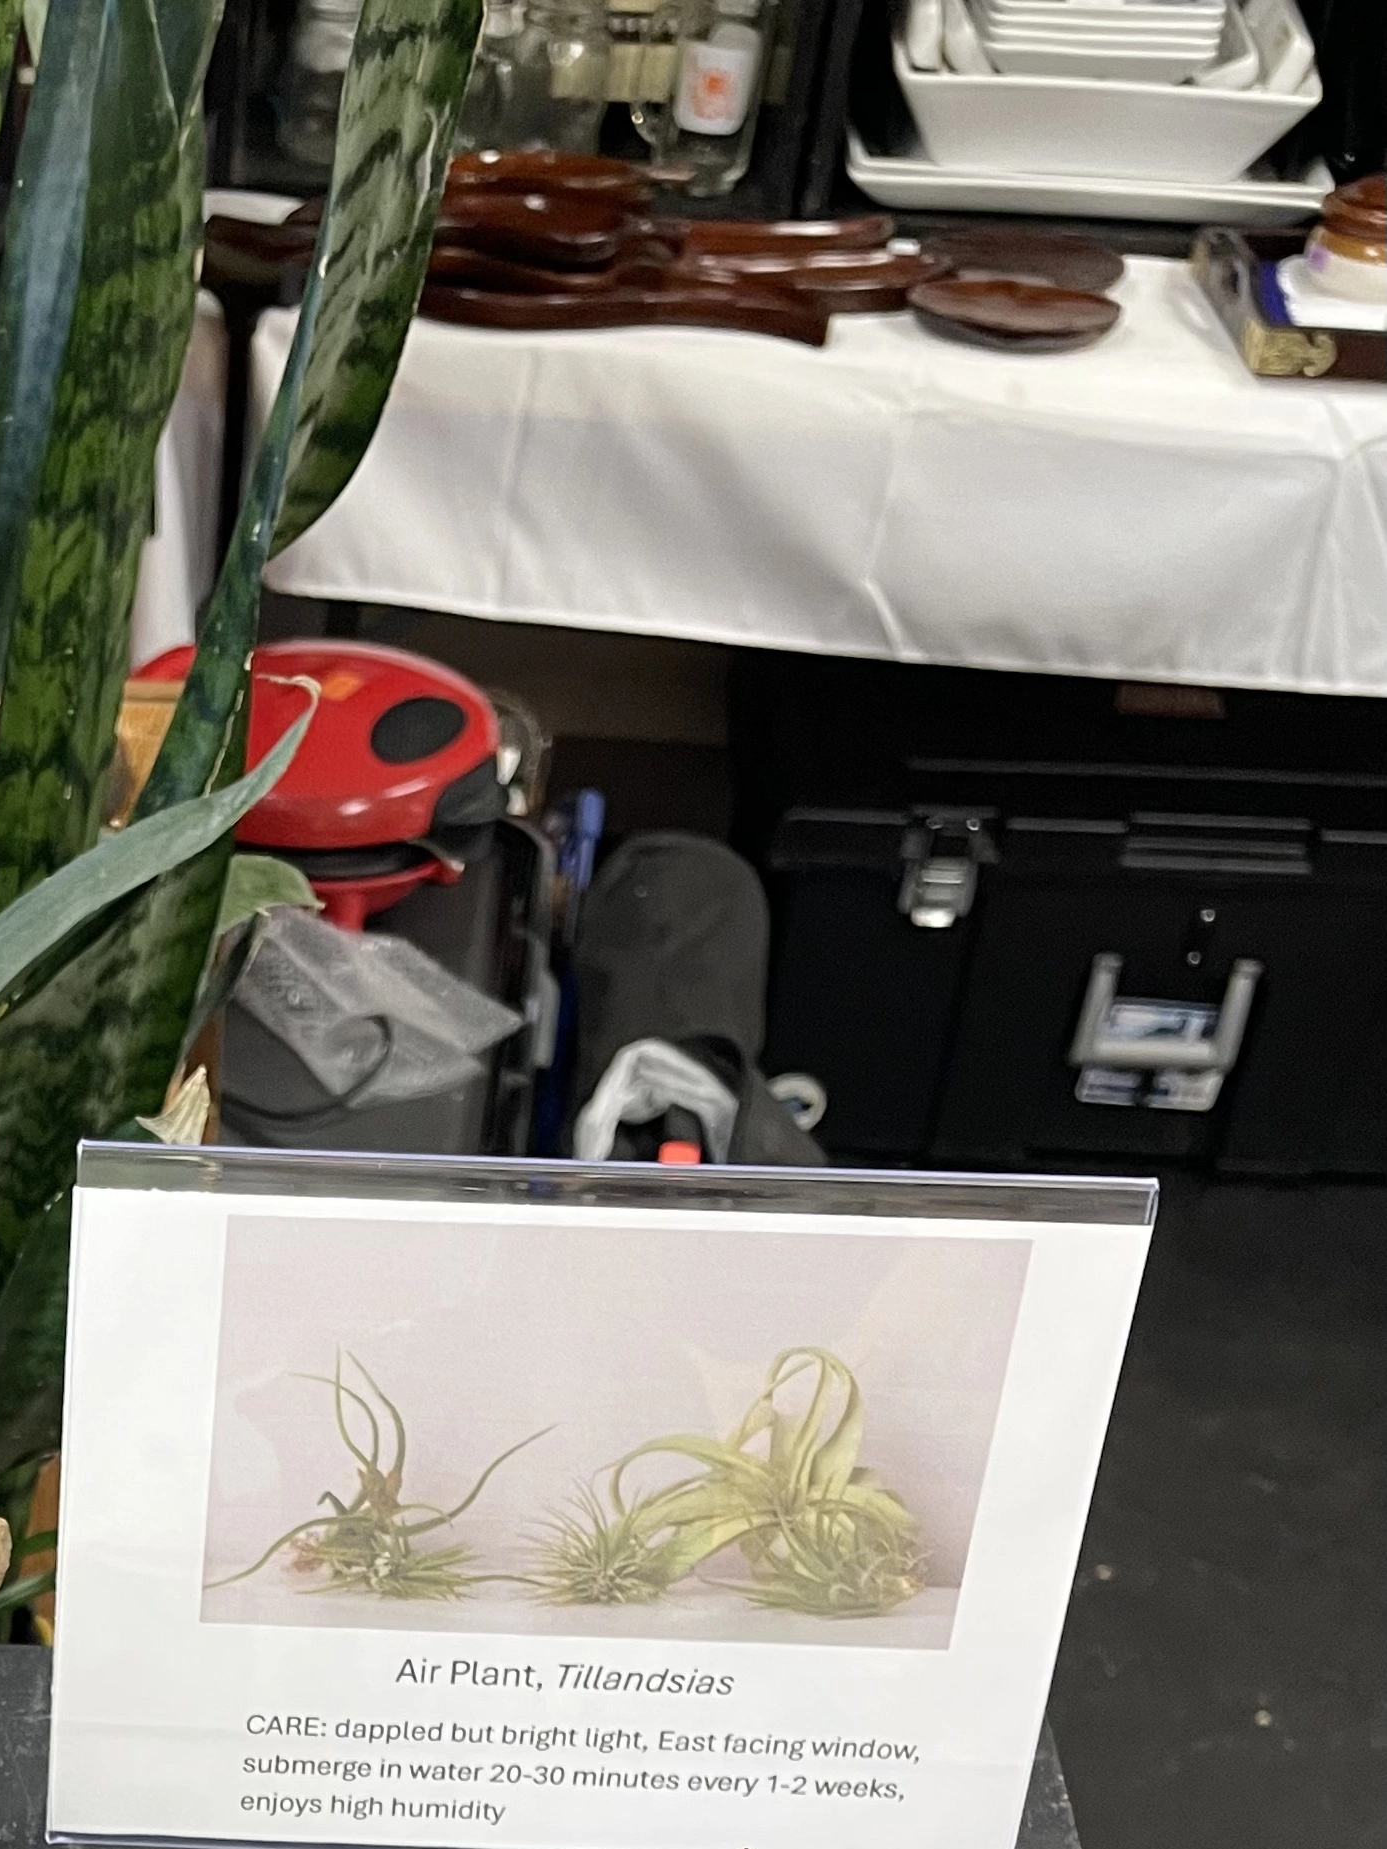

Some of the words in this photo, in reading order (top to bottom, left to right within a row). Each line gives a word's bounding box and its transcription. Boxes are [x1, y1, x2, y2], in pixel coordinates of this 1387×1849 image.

[395, 1658, 442, 1684] Air
[450, 1659, 543, 1692] Plant,
[557, 1663, 735, 1696] Tillandsias
[246, 1714, 327, 1738] CARE:
[334, 1718, 443, 1744] dappled
[451, 1722, 494, 1744] but
[501, 1725, 577, 1751] bright
[585, 1728, 649, 1754] light,
[658, 1730, 716, 1752] East
[723, 1733, 806, 1762] facing
[811, 1739, 920, 1765] window,
[242, 1755, 371, 1781] submerge
[380, 1758, 402, 1779] in
[409, 1763, 483, 1782] water
[489, 1764, 565, 1786] 20-30
[572, 1767, 680, 1791] minutes
[687, 1773, 760, 1797] every
[767, 1774, 807, 1796] 1-2
[814, 1777, 905, 1802] weeks,
[240, 1791, 322, 1817] enjoys
[330, 1794, 384, 1821] high
[391, 1797, 507, 1826] humidity
